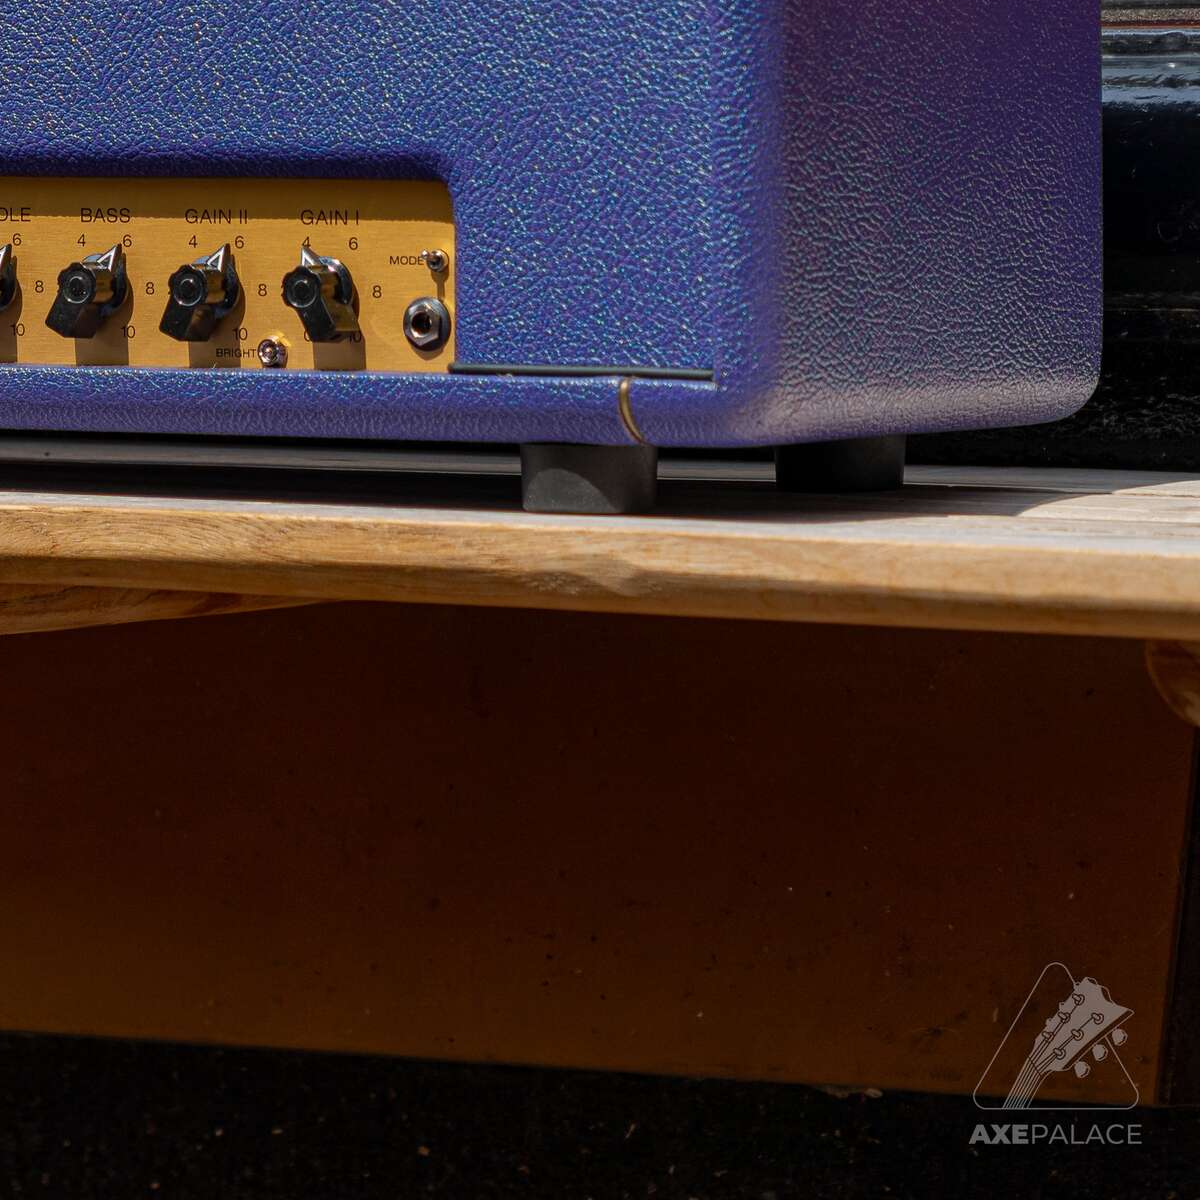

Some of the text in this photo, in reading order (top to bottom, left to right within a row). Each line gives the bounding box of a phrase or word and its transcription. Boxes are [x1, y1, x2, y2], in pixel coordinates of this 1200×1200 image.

[80, 208, 131, 223] BASS
[185, 209, 248, 225] GAIN II
[300, 209, 359, 225] GAIN I
[12, 233, 22, 246] 6
[77, 234, 86, 247] 4
[122, 235, 132, 247] 6
[188, 235, 198, 248] 4
[234, 236, 244, 249] 6
[302, 236, 311, 248] 4
[348, 237, 359, 250] 6
[389, 255, 425, 266] MODE
[35, 280, 44, 293] 8
[145, 282, 155, 295] 8
[258, 284, 267, 297] 8
[372, 285, 382, 298] 8
[11, 323, 25, 336] 10
[122, 325, 136, 338] 10
[233, 328, 247, 341] 10
[215, 348, 257, 358] BRIGHT
